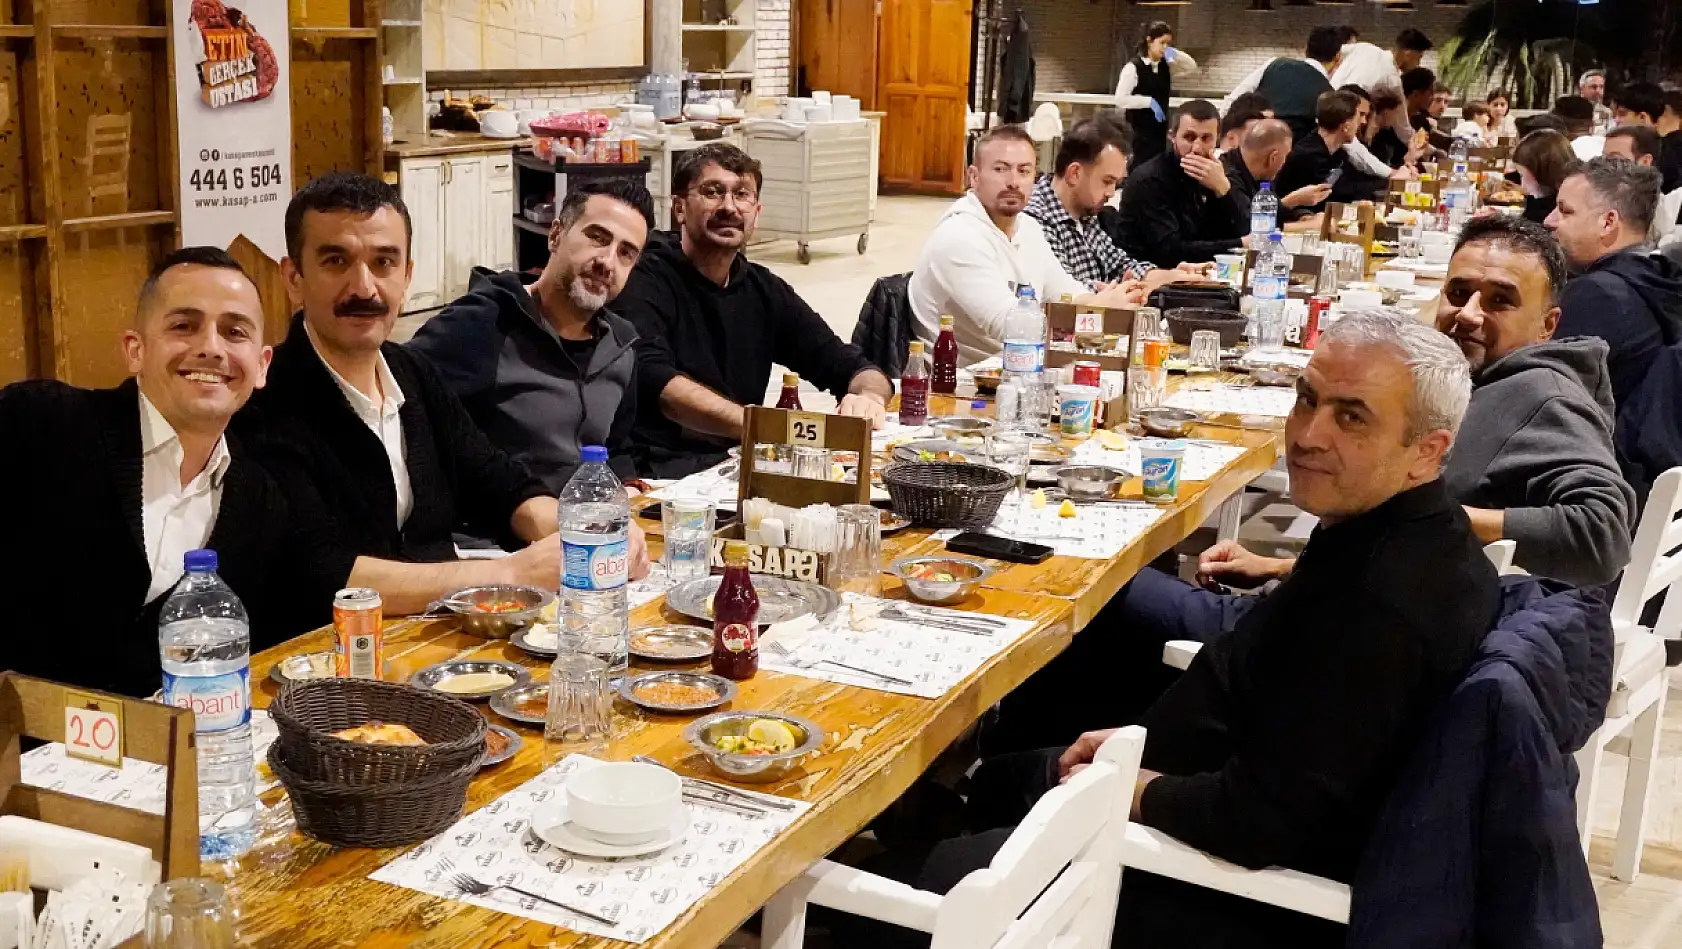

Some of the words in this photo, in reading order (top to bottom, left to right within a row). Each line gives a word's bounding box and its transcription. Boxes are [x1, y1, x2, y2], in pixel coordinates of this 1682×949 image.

[209, 77, 258, 108] USTASI
[190, 168, 228, 191] 444
[233, 167, 244, 190] 6
[251, 163, 281, 188] 504
[194, 193, 278, 208] www.kasap-a.com
[793, 421, 817, 441] 25
[177, 690, 239, 715] abant
[69, 714, 116, 751] 20
